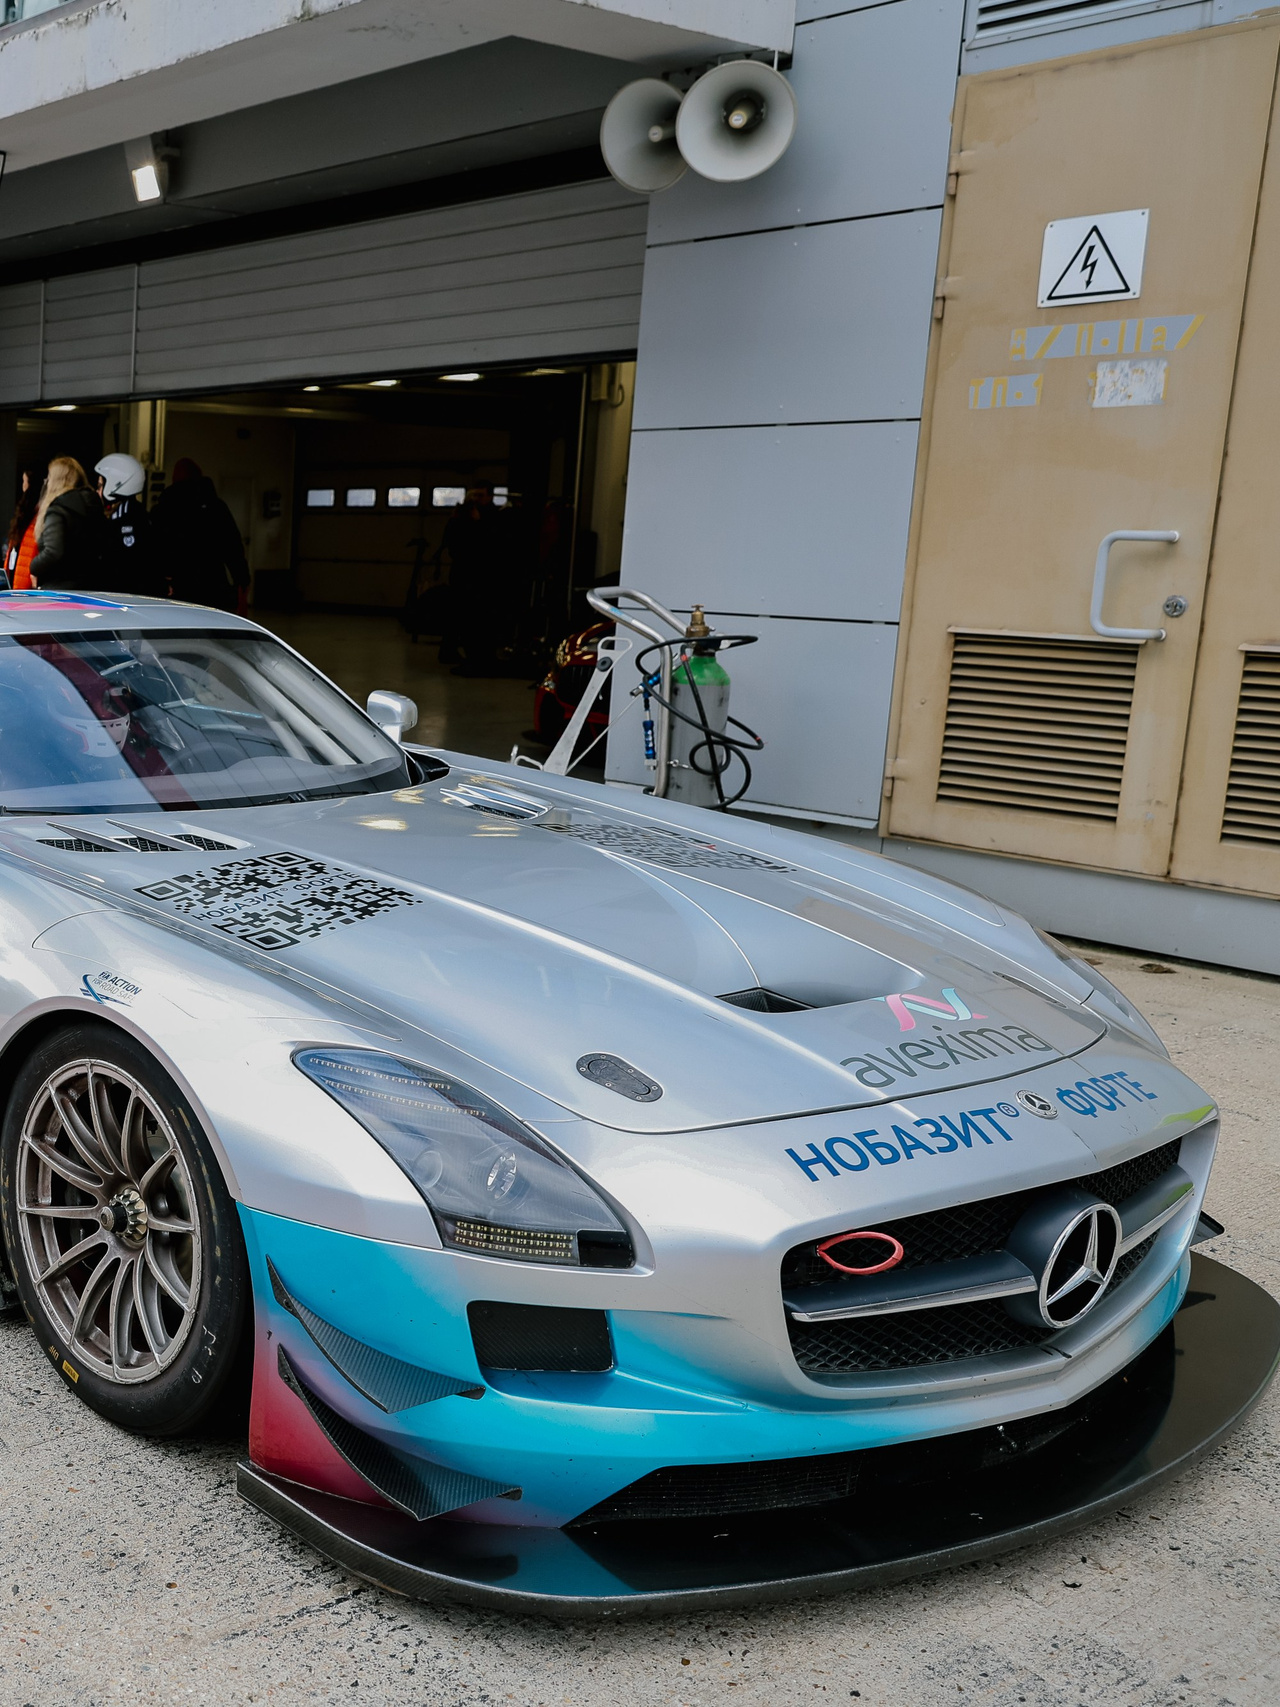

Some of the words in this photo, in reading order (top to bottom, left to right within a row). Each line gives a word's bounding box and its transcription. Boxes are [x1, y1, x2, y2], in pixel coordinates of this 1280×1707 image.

[293, 872, 361, 891] ФОРТЕ
[108, 976, 142, 995] ACTION
[839, 1025, 1053, 1088] avexima
[1055, 1070, 1158, 1118] ФОРТЕ
